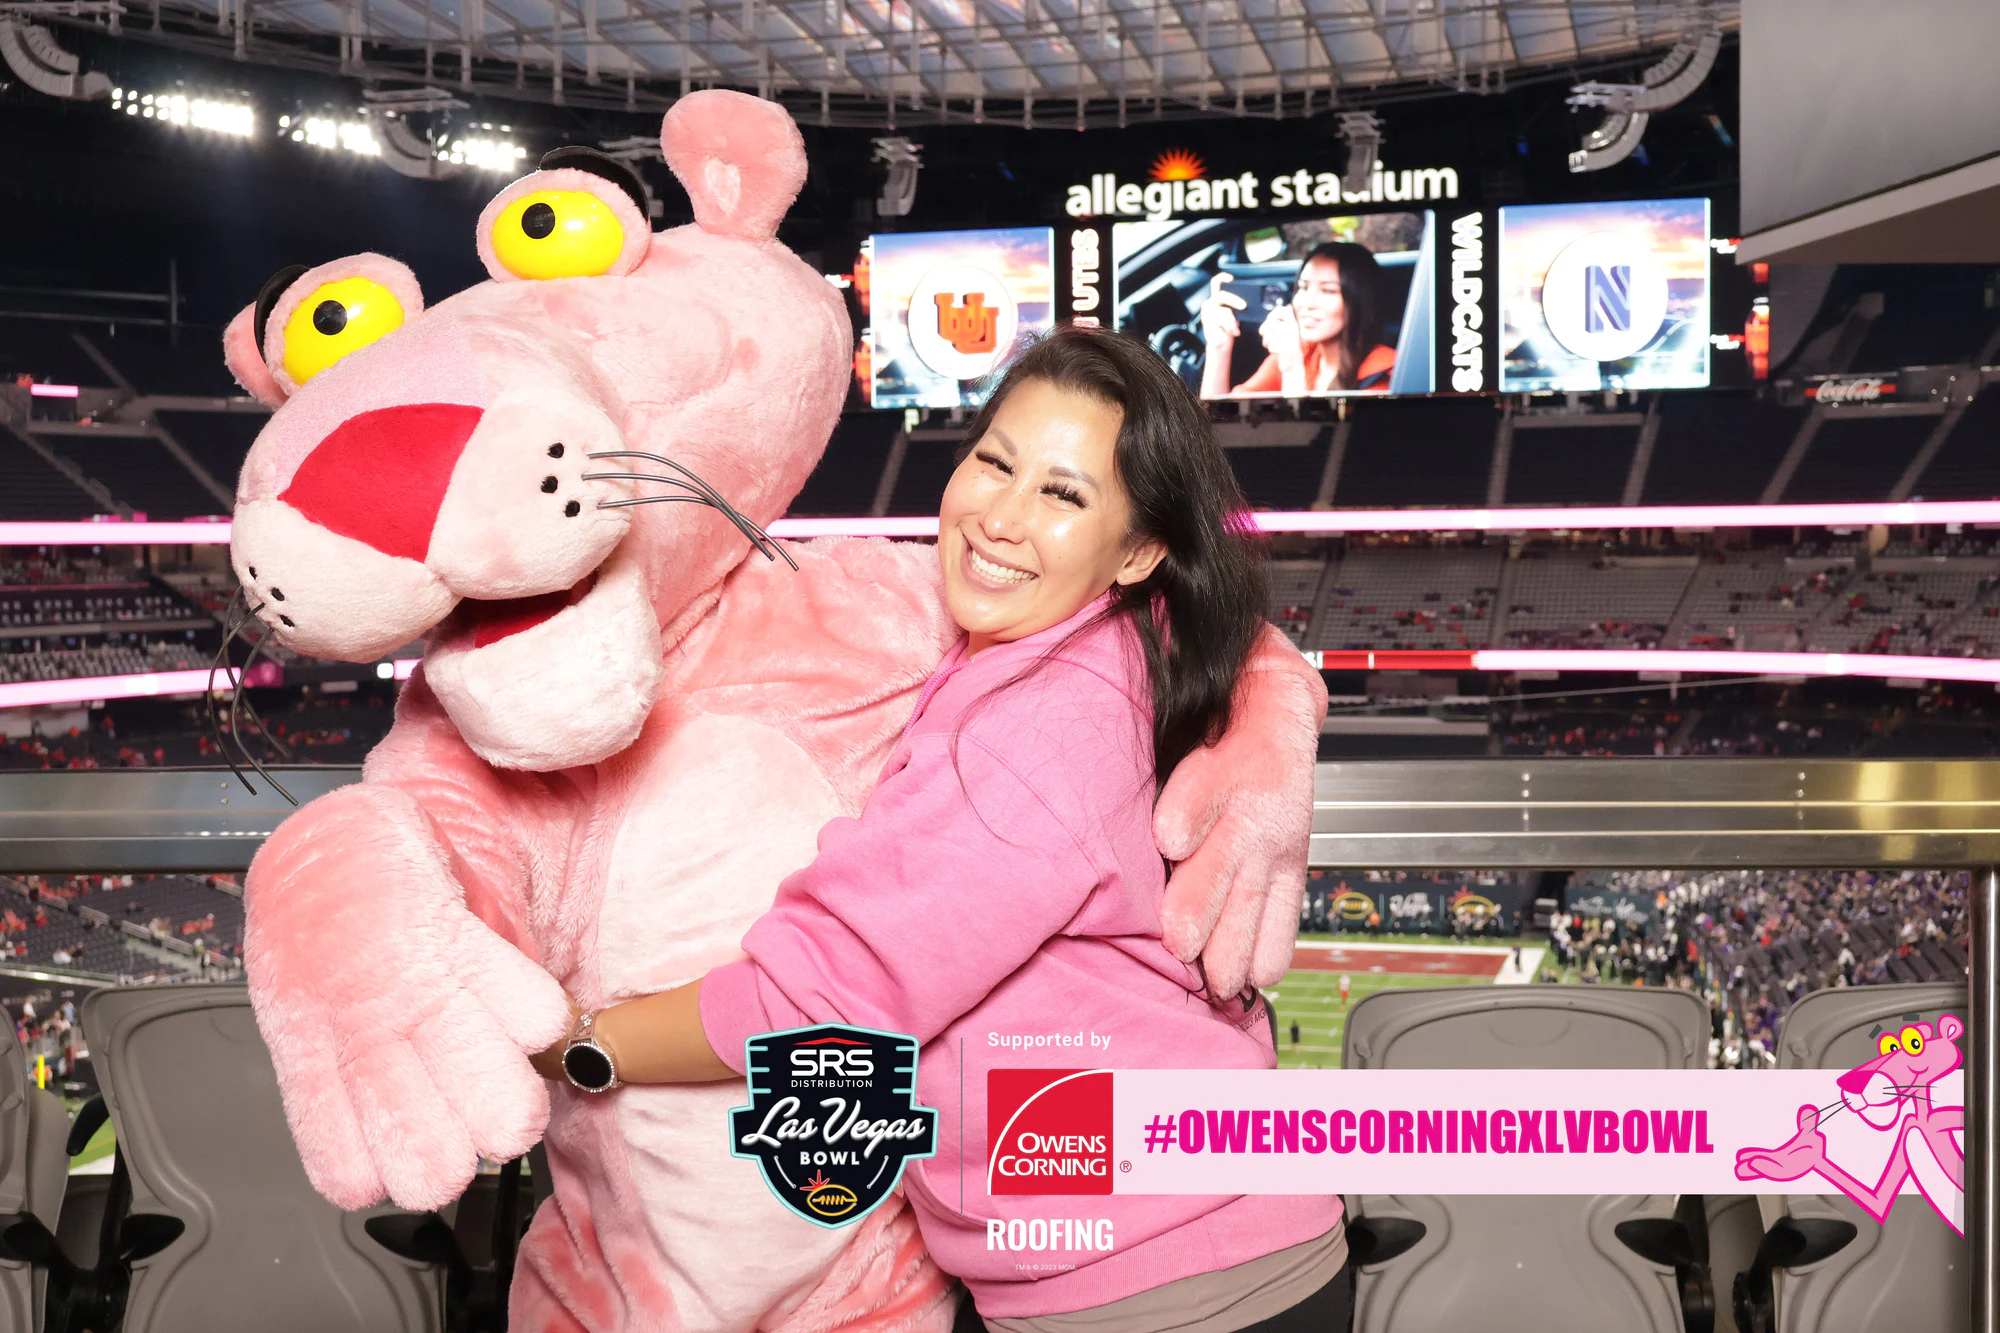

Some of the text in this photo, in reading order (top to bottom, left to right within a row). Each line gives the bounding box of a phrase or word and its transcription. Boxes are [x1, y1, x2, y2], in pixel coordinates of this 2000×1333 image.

[1066, 173, 1258, 222] allegiant
[1072, 229, 1099, 312] UTES
[1452, 212, 1484, 393] WILDCATS
